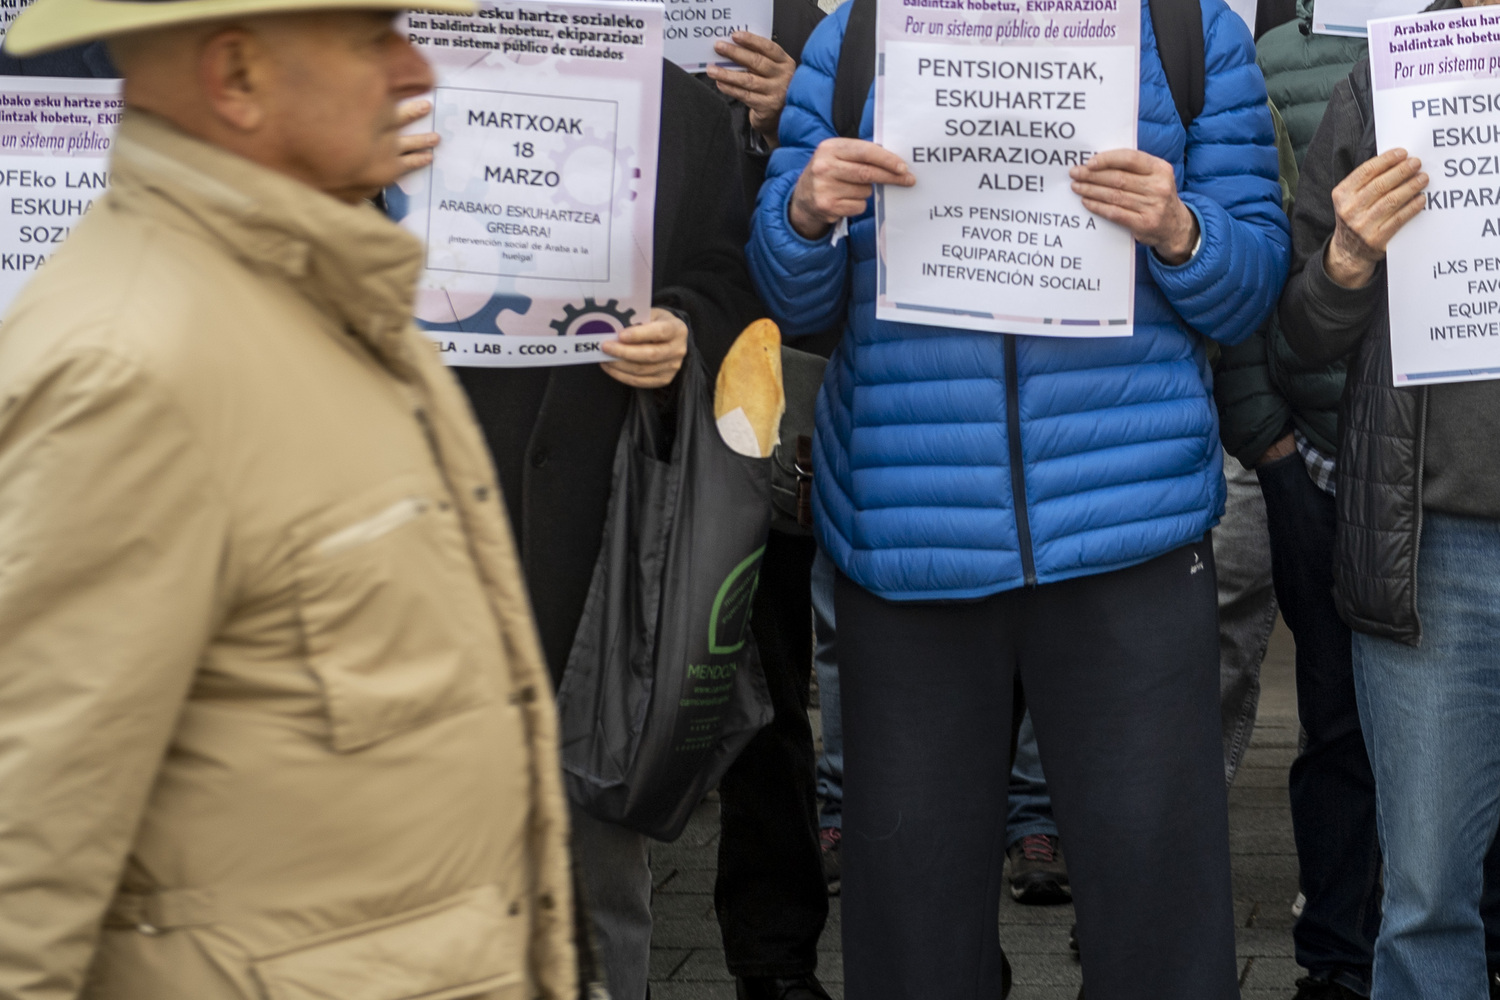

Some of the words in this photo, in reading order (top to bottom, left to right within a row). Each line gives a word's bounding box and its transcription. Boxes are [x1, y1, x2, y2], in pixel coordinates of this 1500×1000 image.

[1026, 0, 1117, 12] EKIPARAZIOA!
[904, 15, 926, 34] Por
[928, 22, 944, 35] un
[946, 19, 993, 38] sistema
[995, 18, 1041, 41] público
[1044, 18, 1060, 39] de
[1063, 18, 1117, 39] cuidados
[918, 58, 1104, 83] PENTSIONISTAK,
[935, 89, 1086, 110] ESKUHARTZE
[468, 109, 582, 135] MARTXOAK
[945, 119, 1076, 139] SOZIALEKO
[513, 142, 535, 158] 18
[912, 146, 1096, 167] EKIPARAZIOARE
[484, 165, 560, 188] MARZO
[978, 173, 1044, 192] ALDE!
[929, 205, 964, 221] ¡LXS
[969, 206, 1080, 229] PENSIONISTAS
[1085, 216, 1096, 230] A
[961, 225, 1012, 243] FAVOR
[1017, 231, 1038, 246] DE
[1044, 233, 1063, 248] LA
[941, 244, 1055, 268] EQUIPARACIÓN
[1060, 256, 1082, 270] DE
[922, 262, 1034, 287] INTERVENCIÓN
[1039, 275, 1101, 291] SOCIAL!
[474, 343, 501, 355] LAB
[518, 344, 557, 355] CCOO
[574, 342, 600, 353] ESK
